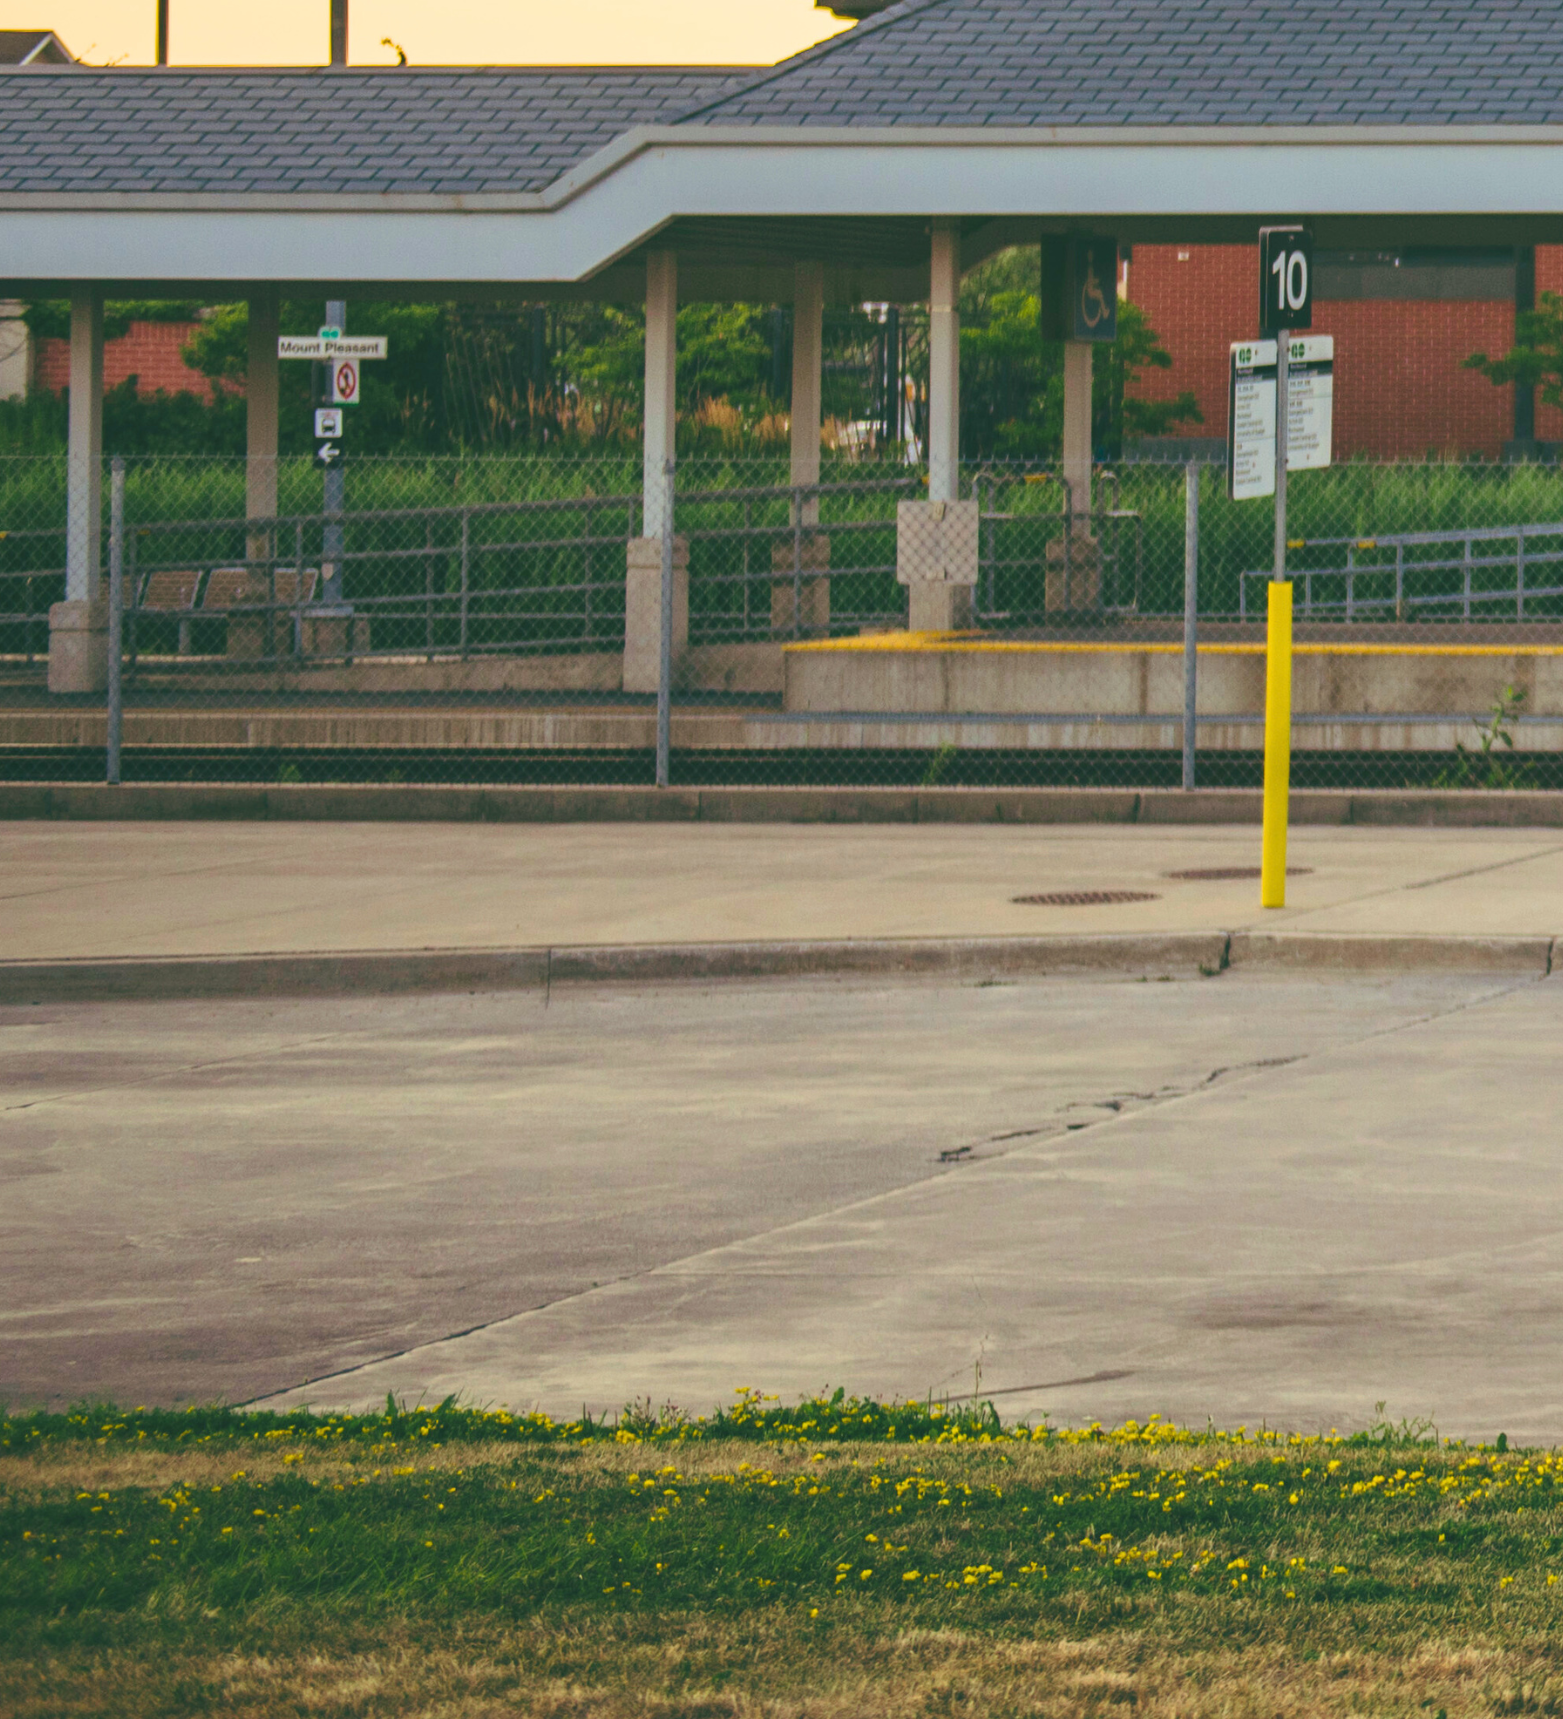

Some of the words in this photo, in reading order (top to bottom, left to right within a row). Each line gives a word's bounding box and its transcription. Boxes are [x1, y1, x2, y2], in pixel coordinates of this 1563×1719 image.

[1272, 250, 1308, 310] 10
[281, 342, 320, 353] Mount
[325, 342, 379, 353] Pleasant
[1291, 343, 1305, 358] GO
